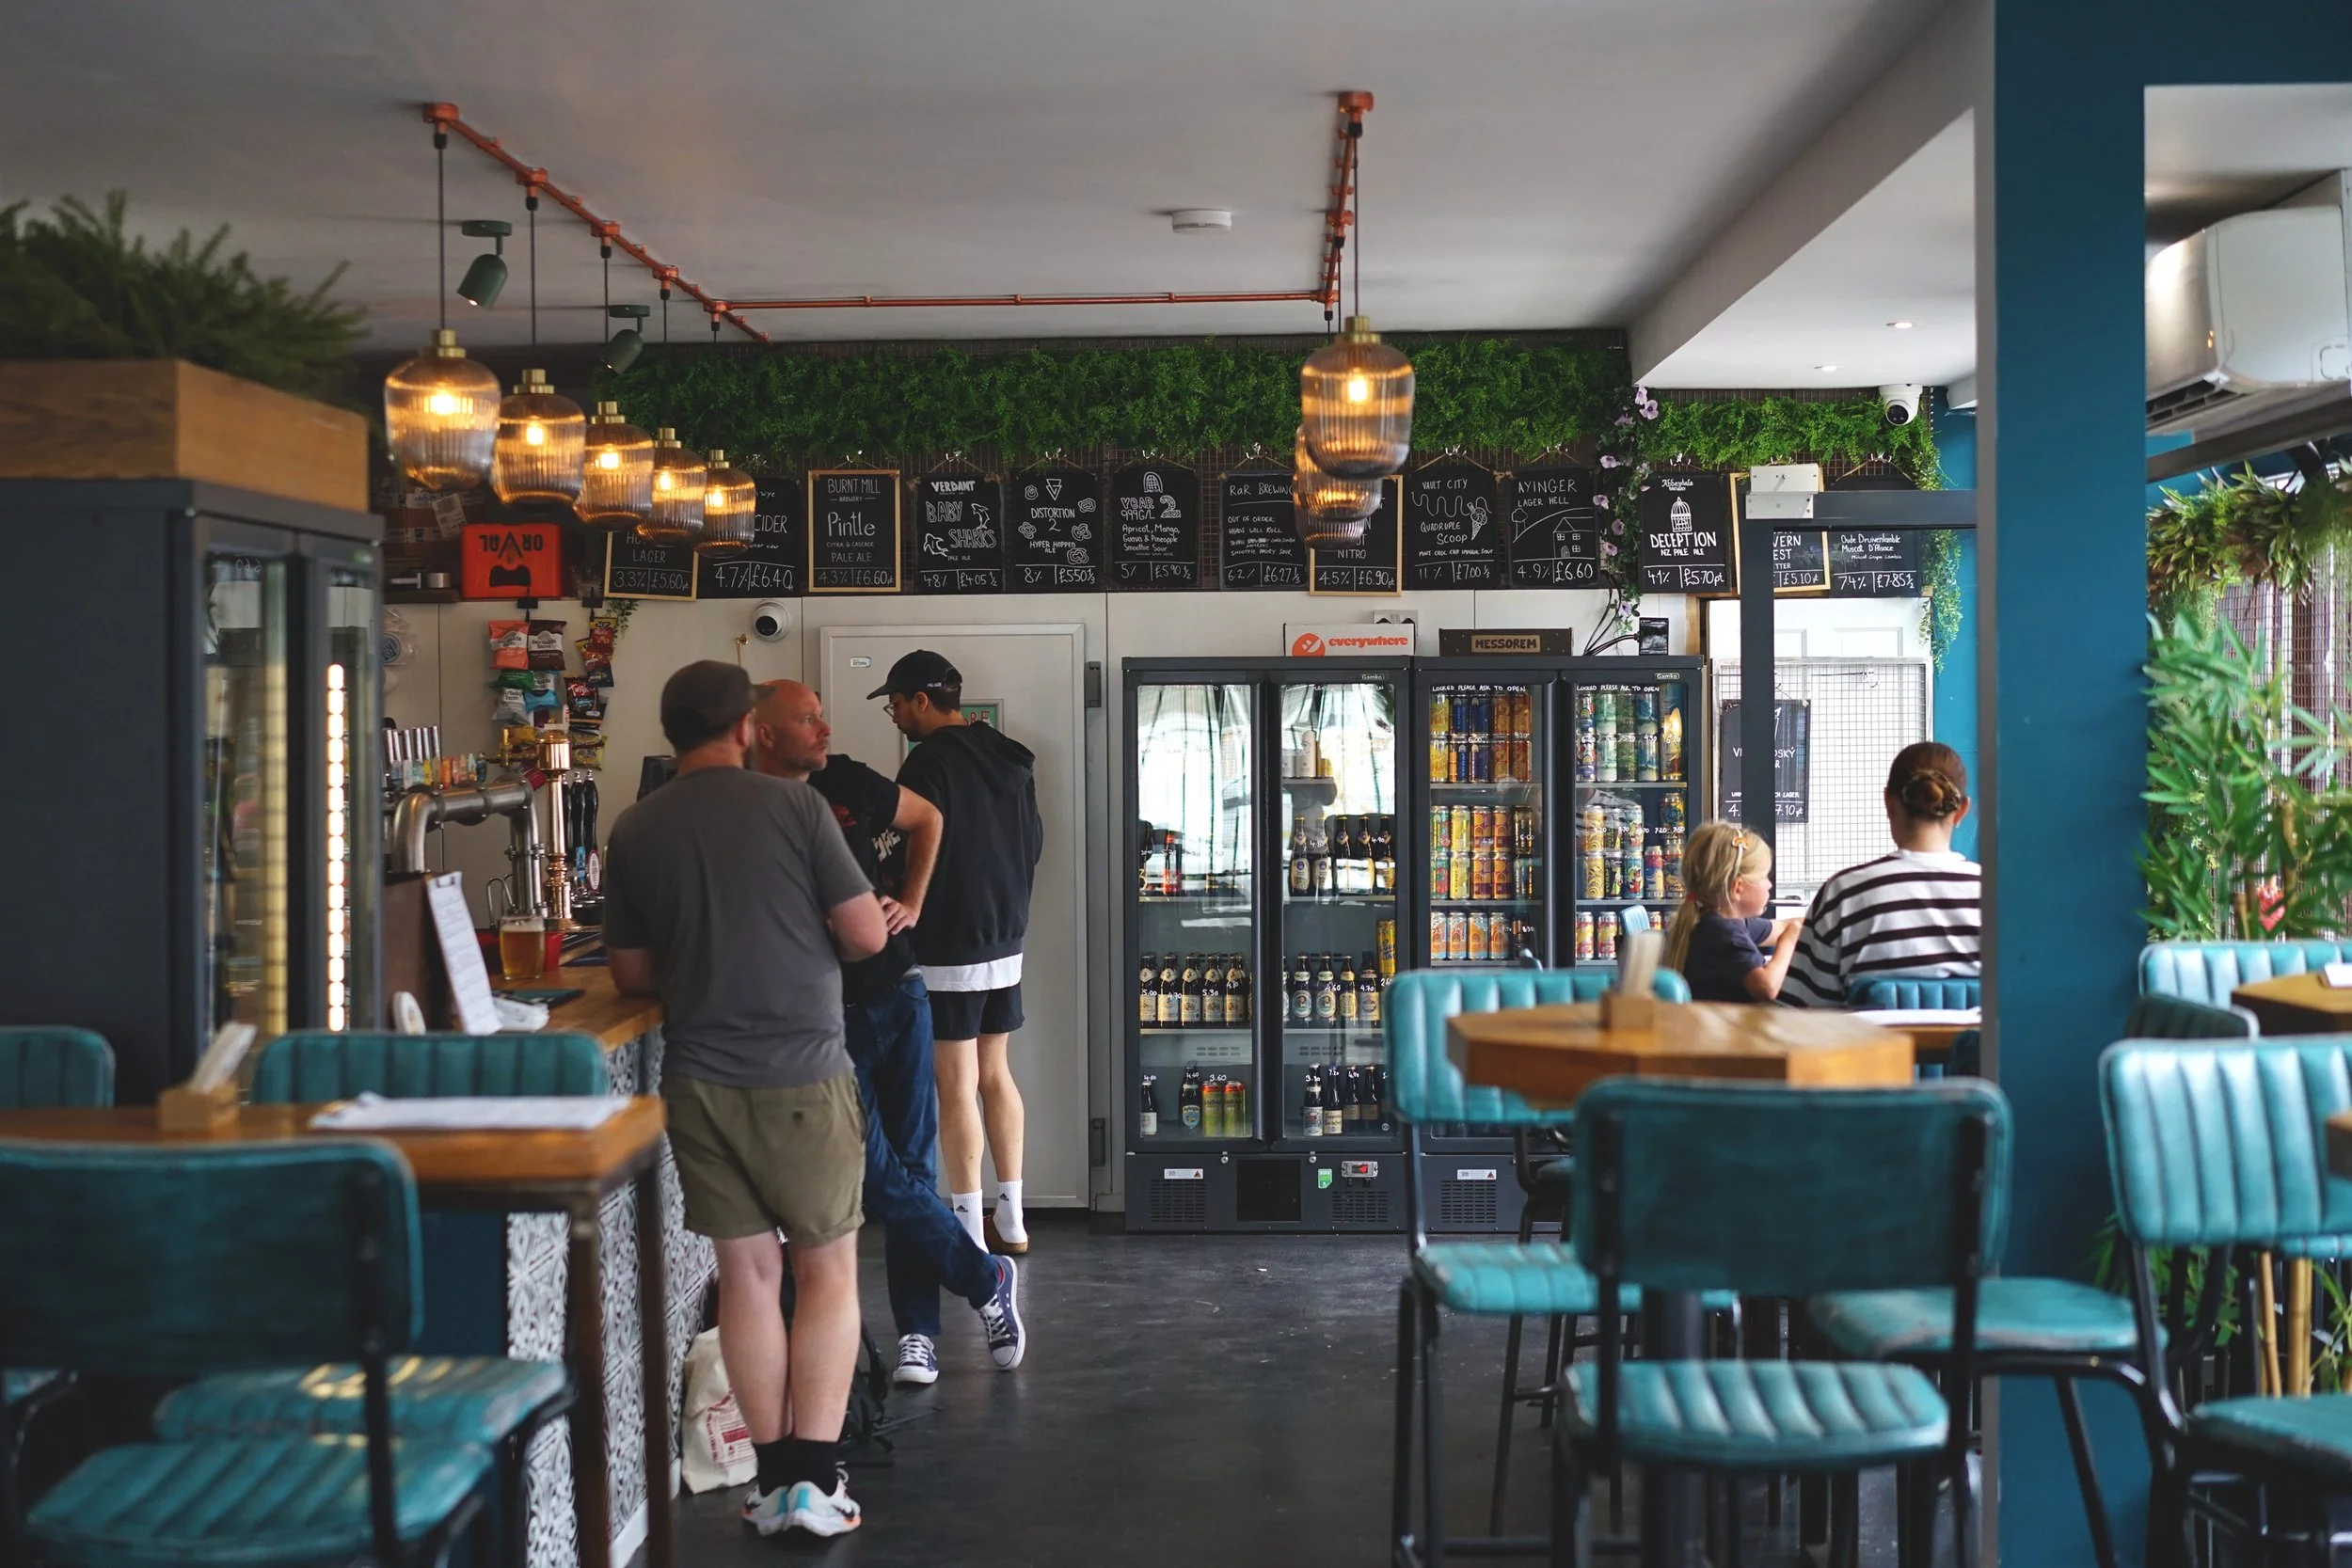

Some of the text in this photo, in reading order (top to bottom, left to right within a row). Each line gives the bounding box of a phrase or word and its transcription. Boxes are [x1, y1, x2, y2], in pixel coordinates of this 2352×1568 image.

[828, 478, 882, 494] BURNT MILL
[930, 481, 976, 492] VERDANT
[1230, 483, 1251, 496] RaR
[1422, 478, 1468, 490] VAULT CITY
[1518, 478, 1578, 494] AYINGER
[1661, 479, 1693, 488] Abbeydale
[1120, 495, 1182, 518] YEAR 2
[1518, 496, 1569, 508] LAGER HELL
[926, 501, 962, 522] BABY
[1030, 507, 1075, 518] DISTORTION
[754, 514, 787, 534] CIDER
[828, 512, 876, 537] Pintle
[1049, 518, 1061, 531] 2
[1121, 524, 1180, 536] Apricot, Mango,
[1420, 521, 1460, 533] QUADRUPLE
[948, 528, 997, 548] SHARKS
[1030, 540, 1051, 548] HYPER
[1122, 534, 1143, 543] Guava
[1151, 534, 1178, 545] Pineapple
[1436, 532, 1468, 545] SCOOP
[1649, 531, 1717, 547] DECEPTION
[1840, 534, 1856, 544] Oude
[632, 549, 666, 563] LAGER
[831, 552, 872, 562] PALE ALE
[1337, 548, 1367, 560] NITRO
[1674, 547, 1690, 556] PALE
[1773, 548, 1792, 561] EST
[818, 570, 849, 584] 4.3%
[1025, 567, 1042, 583] 8%
[1318, 570, 1350, 586] 4.5%
[1517, 561, 1594, 582] 4.9% £6.60
[613, 570, 646, 589] 3.3%
[1327, 635, 1409, 649] everywhere
[1474, 638, 1537, 650] MESSOREM
[1201, 989, 1219, 997] 5.30
[1359, 984, 1375, 992] 4.70
[1209, 1073, 1227, 1083] 3.60
